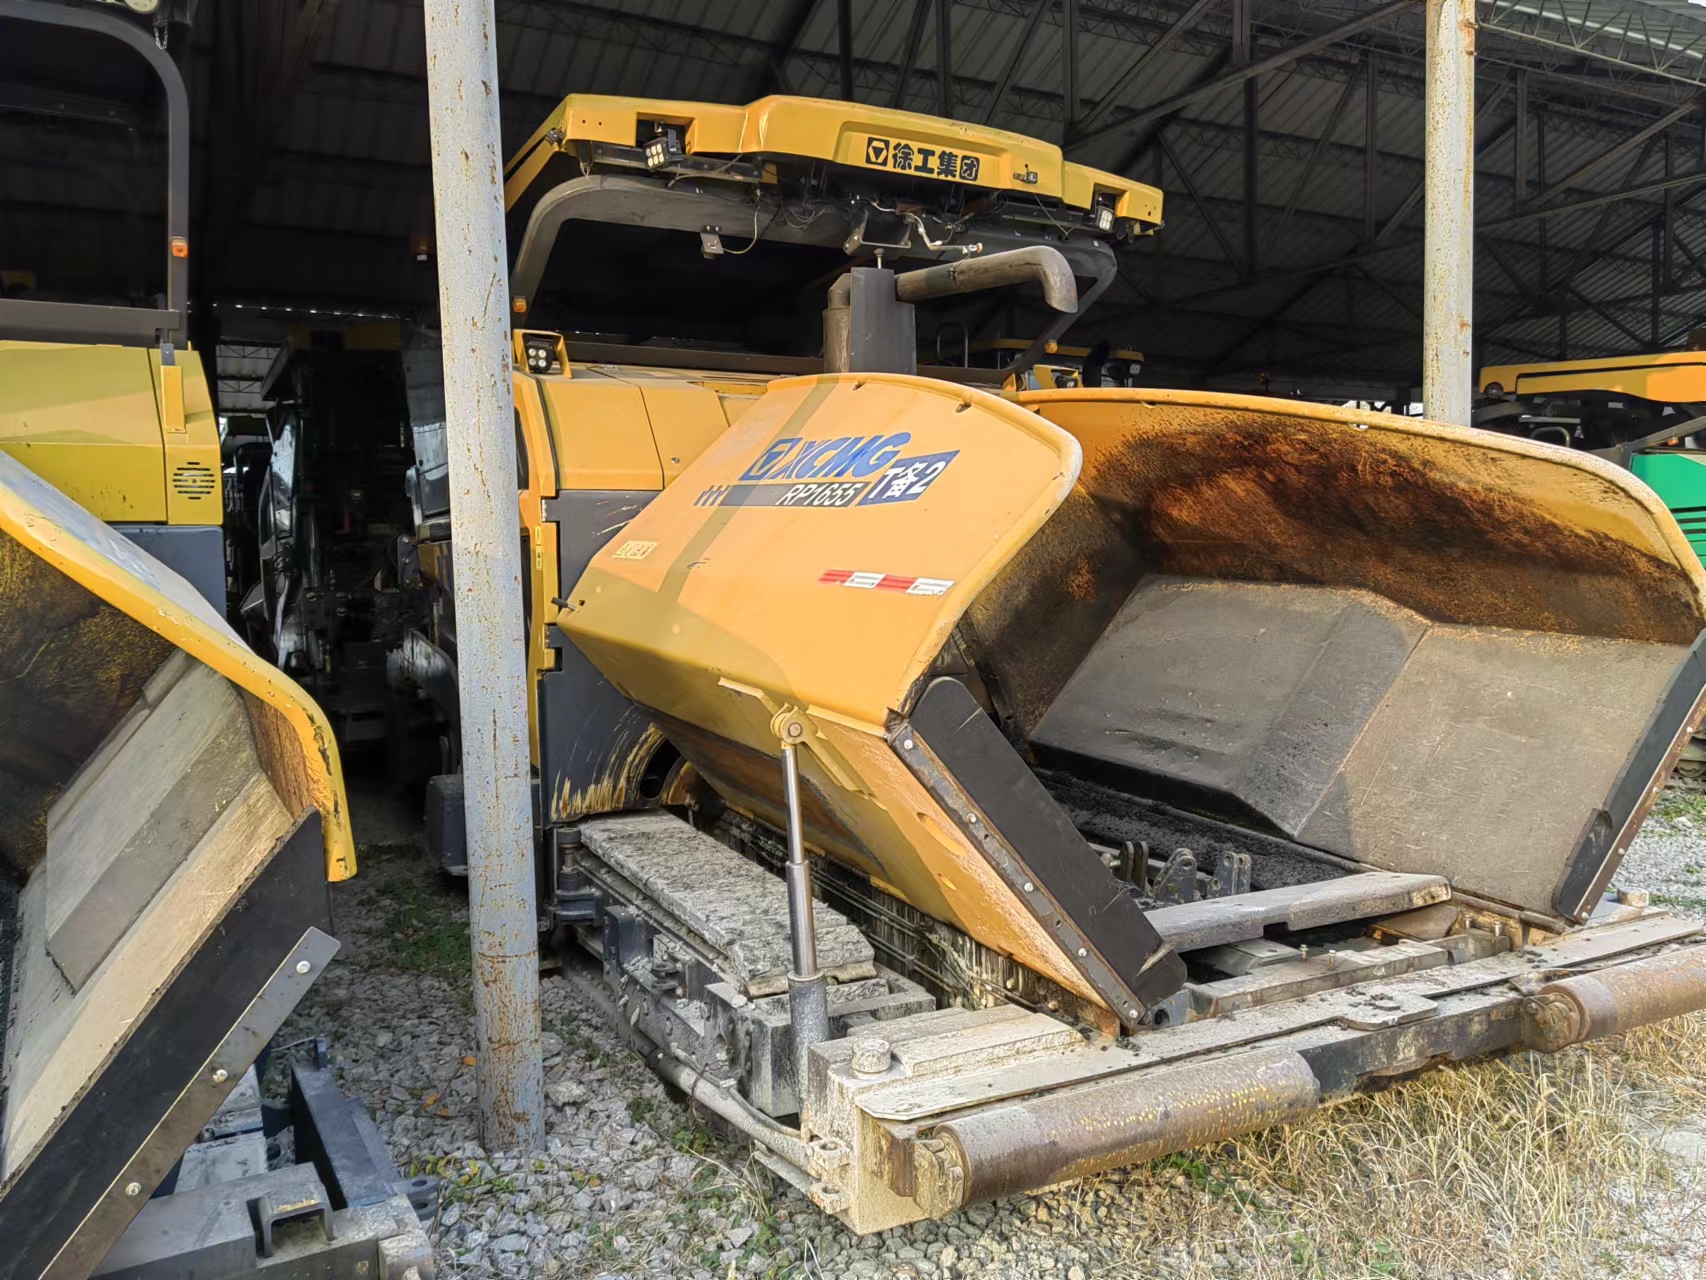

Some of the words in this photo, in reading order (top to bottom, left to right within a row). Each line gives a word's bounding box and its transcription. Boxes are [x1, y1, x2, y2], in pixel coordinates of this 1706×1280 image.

[892, 141, 980, 182] 徐工集团
[764, 432, 912, 479] XCMG
[775, 483, 865, 506] RP1655
